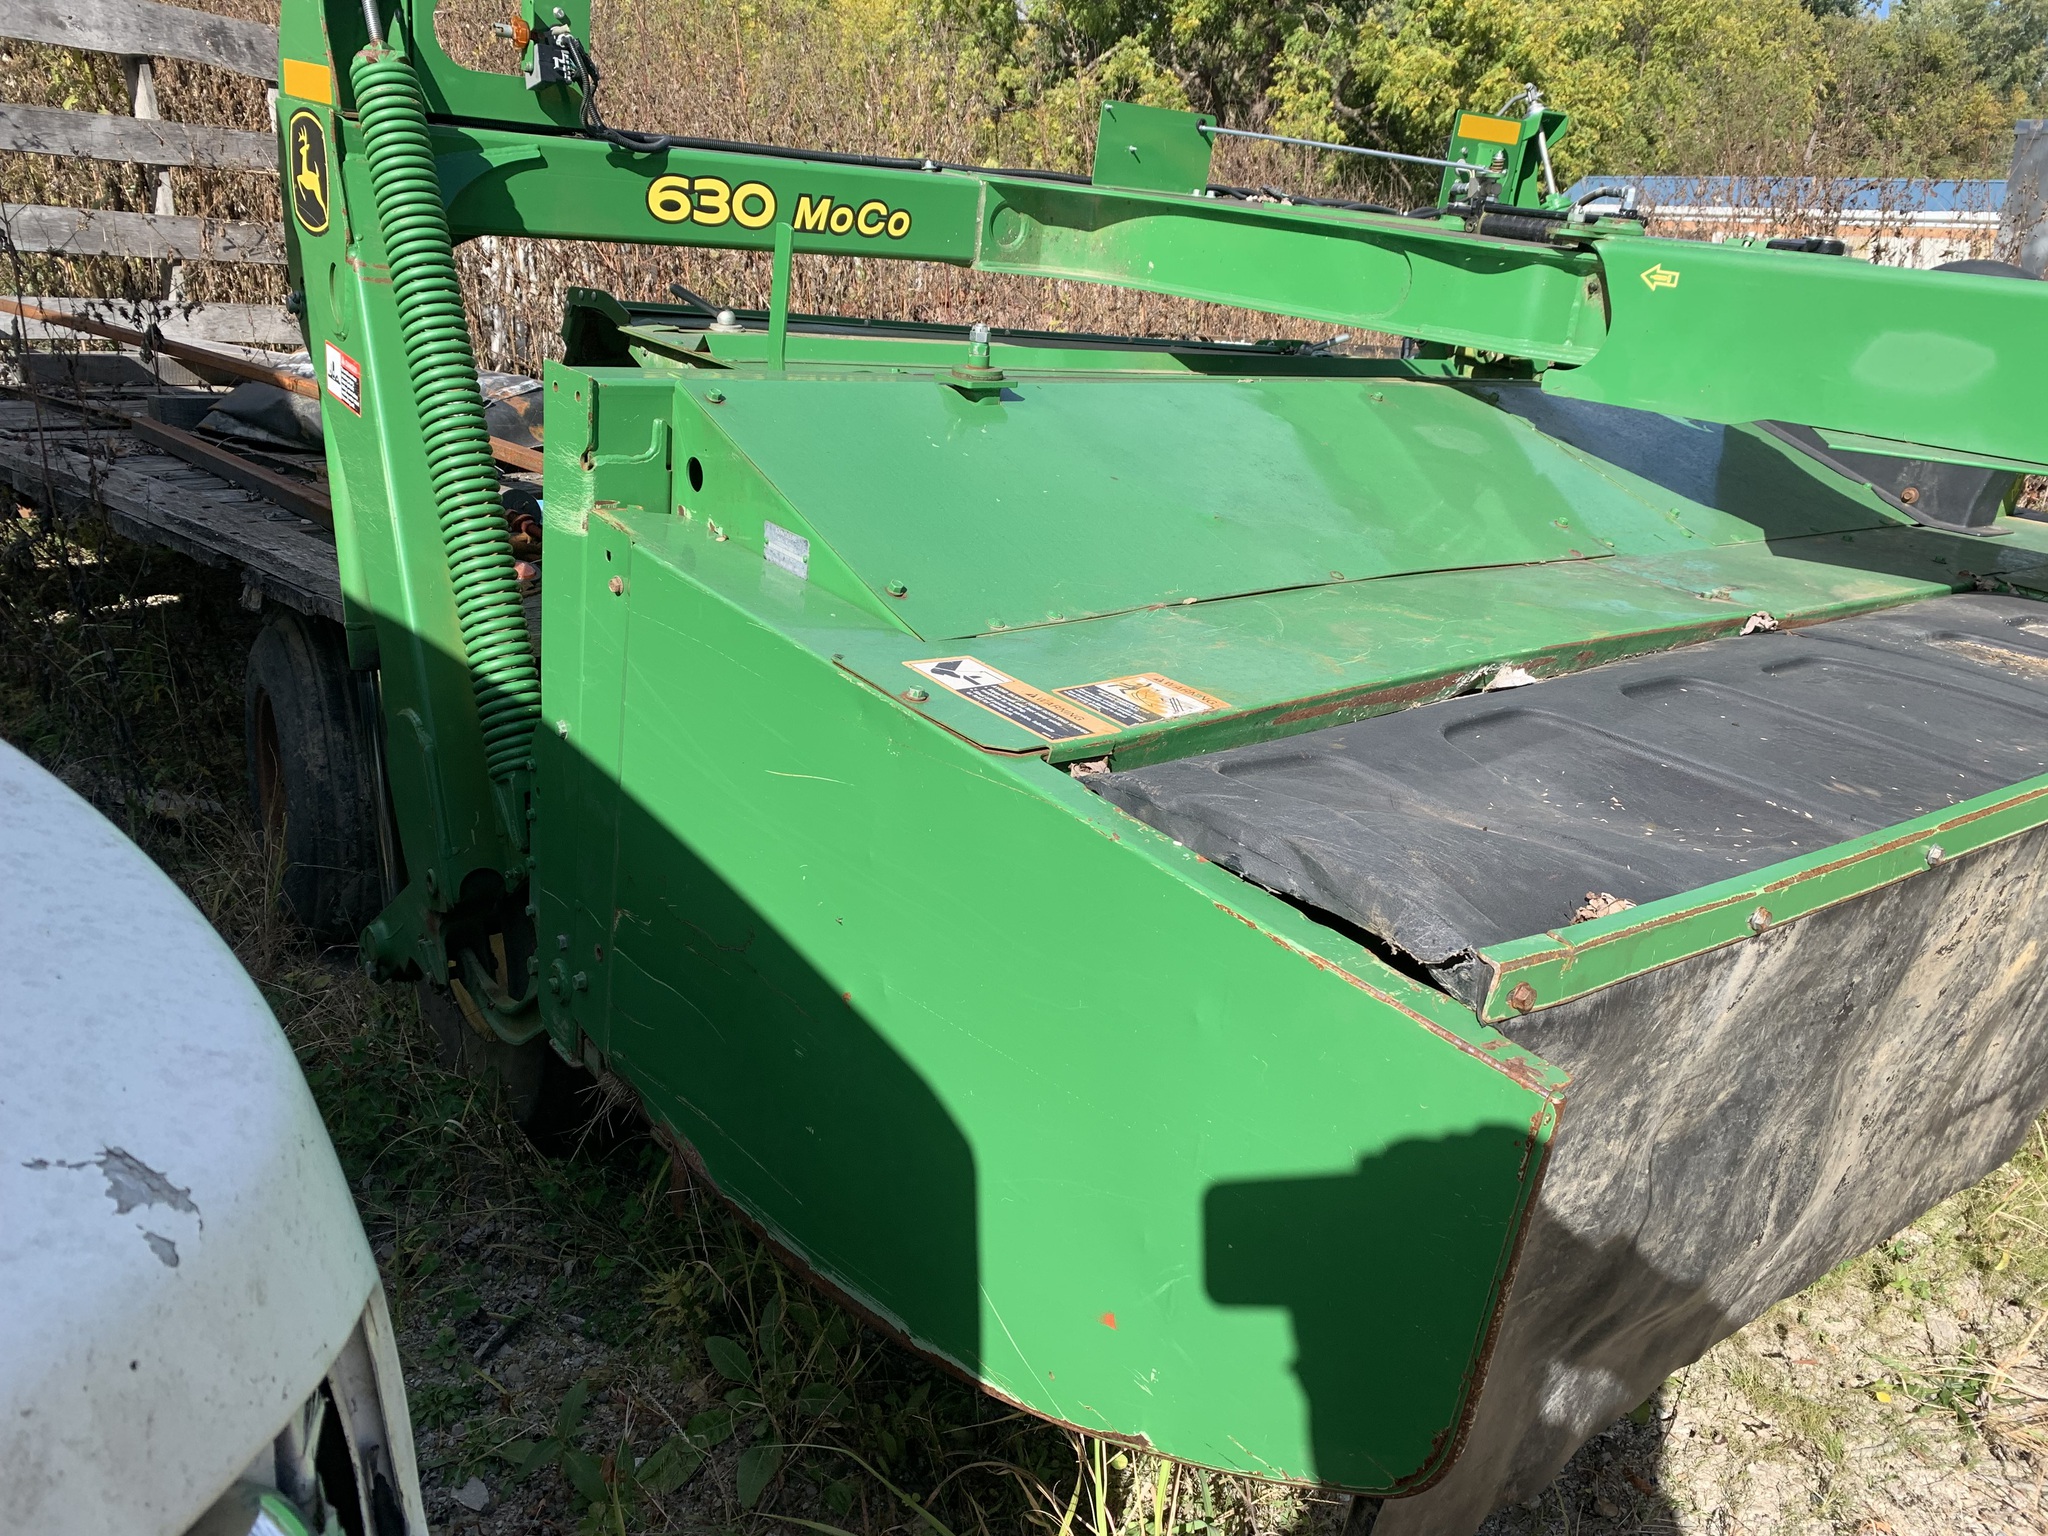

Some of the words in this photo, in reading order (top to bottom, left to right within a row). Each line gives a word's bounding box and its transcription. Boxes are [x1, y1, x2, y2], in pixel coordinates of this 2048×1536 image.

[647, 172, 778, 230] 630
[793, 193, 912, 239] MoCo
[1164, 681, 1218, 705] WARNNG
[1037, 697, 1085, 721] WARNING
